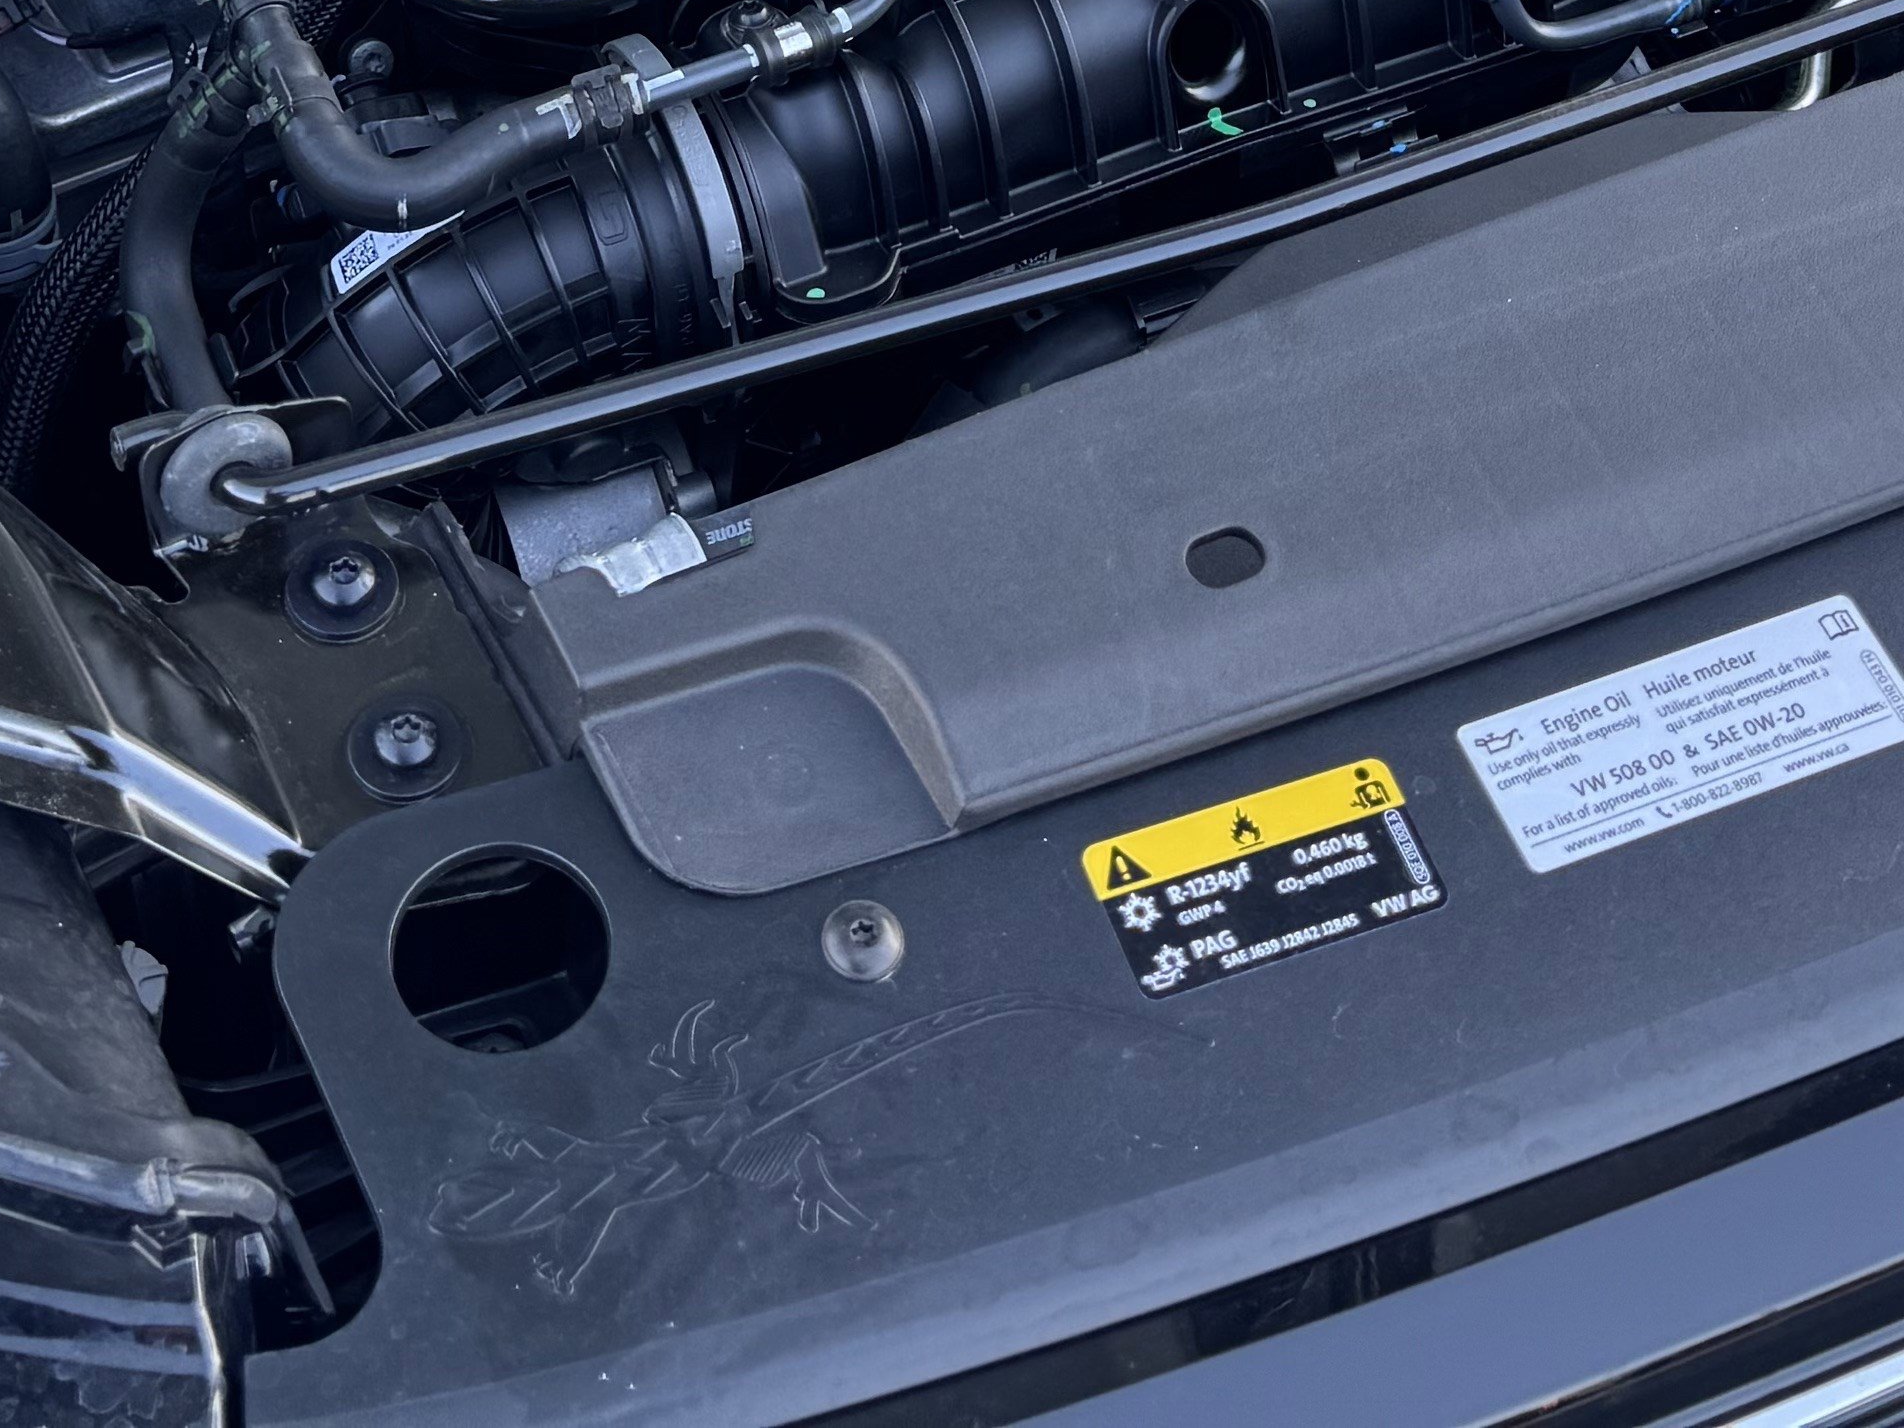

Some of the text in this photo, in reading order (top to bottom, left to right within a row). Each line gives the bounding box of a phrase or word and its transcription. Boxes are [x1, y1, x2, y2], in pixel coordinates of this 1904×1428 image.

[1644, 648, 1757, 700] Huile moteur
[1656, 648, 1832, 718] Utilisez uniquement de l'huile
[1541, 690, 1631, 736] Engine Oil
[1666, 665, 1830, 736] qui satisfait expressément à
[1487, 714, 1641, 776] Use only oil that expressly
[1570, 702, 1806, 799] VW 508 00 & SAE 0W-20
[1691, 700, 1888, 779] Pour une liste d'huiles approuvées:
[1497, 752, 1582, 792] complies with
[1564, 741, 1850, 854] www.vw.com 1-800-822-8987 www.vw.ca
[1523, 822, 1544, 839] For
[1555, 809, 1574, 828] list
[1575, 804, 1590, 820] of
[1593, 785, 1640, 818] approved
[1641, 777, 1678, 798] oils:
[1293, 830, 1369, 866] 0.460 kg
[1324, 857, 1363, 879] 0.0018
[1165, 861, 1253, 906] R-1234yf
[1371, 884, 1441, 918] VW AG
[1177, 900, 1227, 926] GWP 4
[1190, 929, 1238, 960] PAG
[1219, 913, 1360, 970] SAE J639 J2842 J2845
